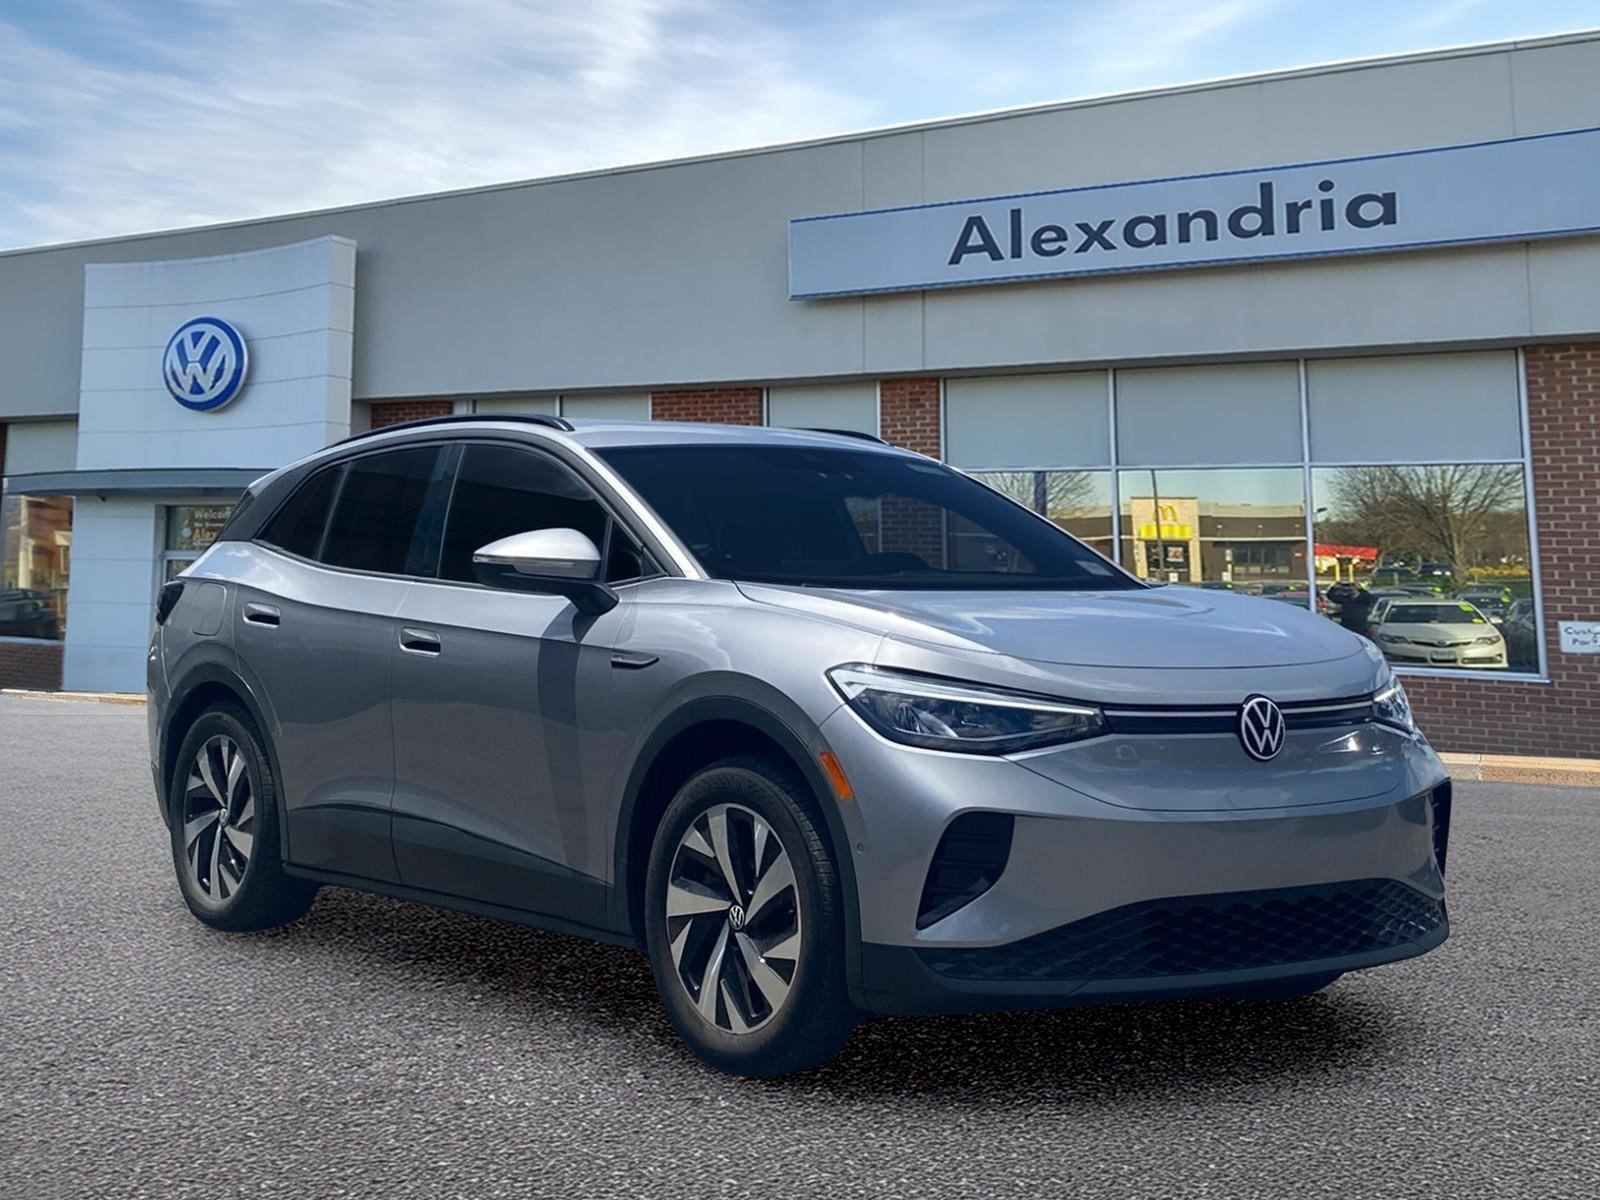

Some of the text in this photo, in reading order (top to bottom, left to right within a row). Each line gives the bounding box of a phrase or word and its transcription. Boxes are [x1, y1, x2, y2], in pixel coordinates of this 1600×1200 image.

[947, 179, 1398, 266] Alexandria
[163, 321, 239, 404] VW
[1242, 699, 1284, 758] VW
